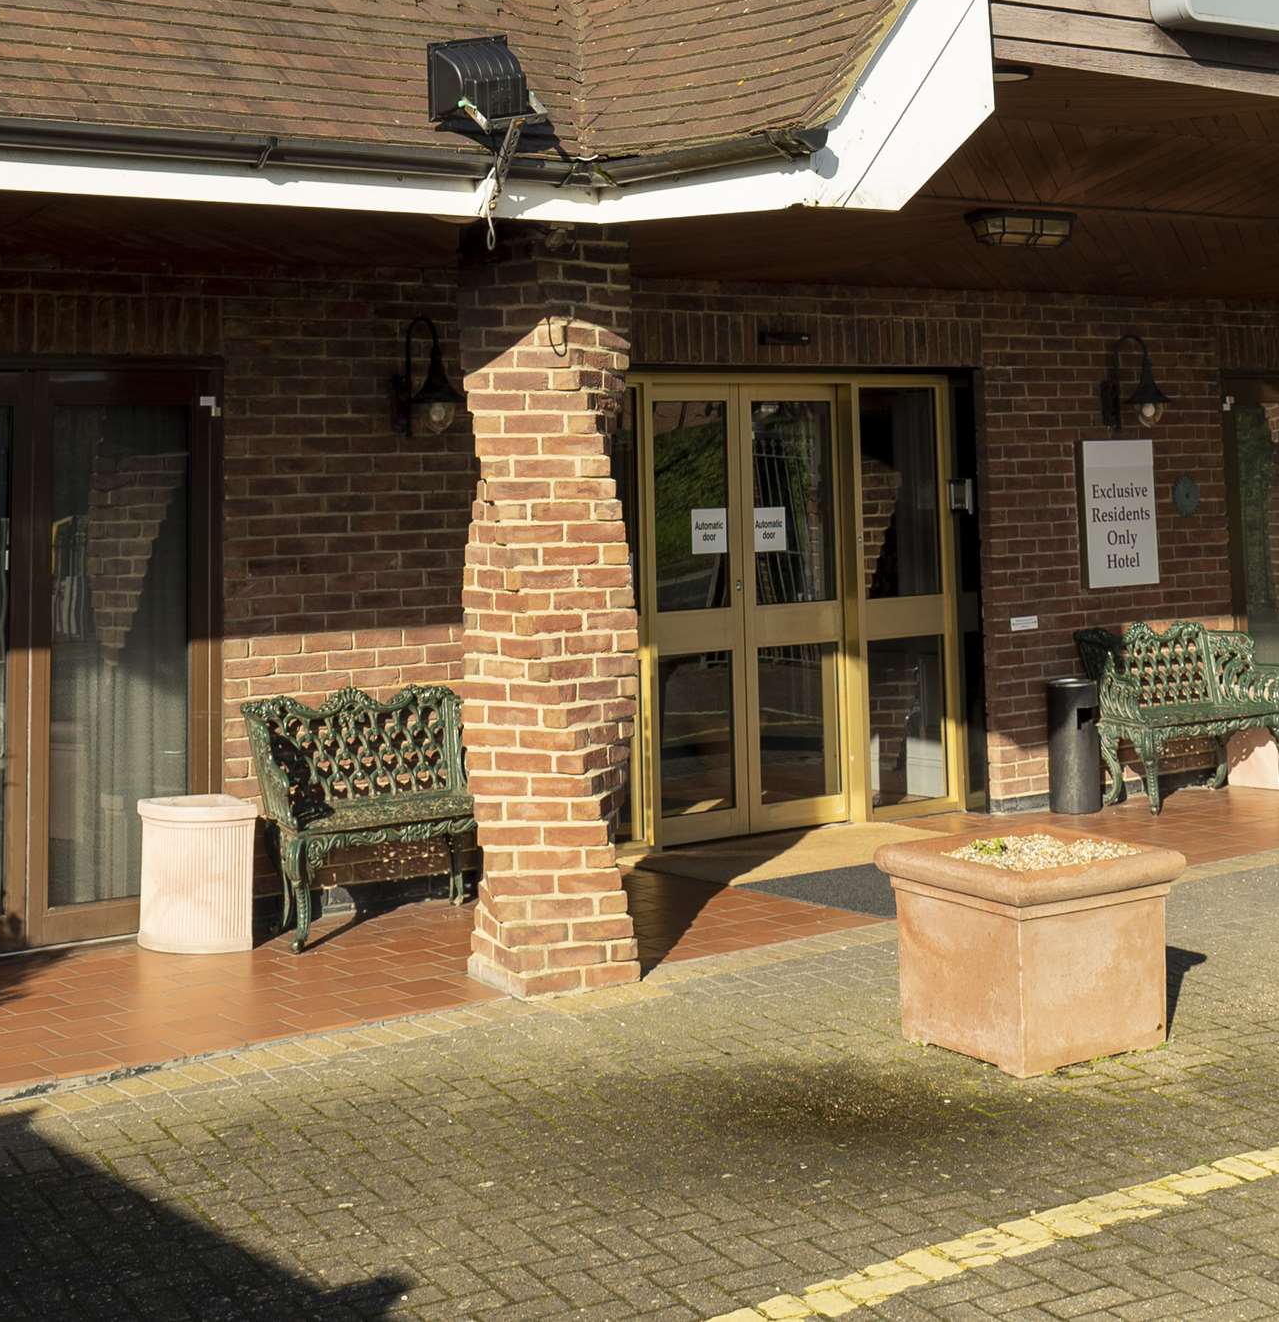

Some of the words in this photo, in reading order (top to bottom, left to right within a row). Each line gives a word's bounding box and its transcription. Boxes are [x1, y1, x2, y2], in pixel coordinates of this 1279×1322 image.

[1091, 482, 1148, 499] Exclusive
[1091, 506, 1151, 523] Residents
[695, 521, 723, 530] Automatic
[755, 520, 782, 528] Automatic
[703, 533, 716, 541] door
[762, 531, 776, 539] door
[1107, 530, 1138, 549] Only
[1107, 552, 1140, 569] Hotel
